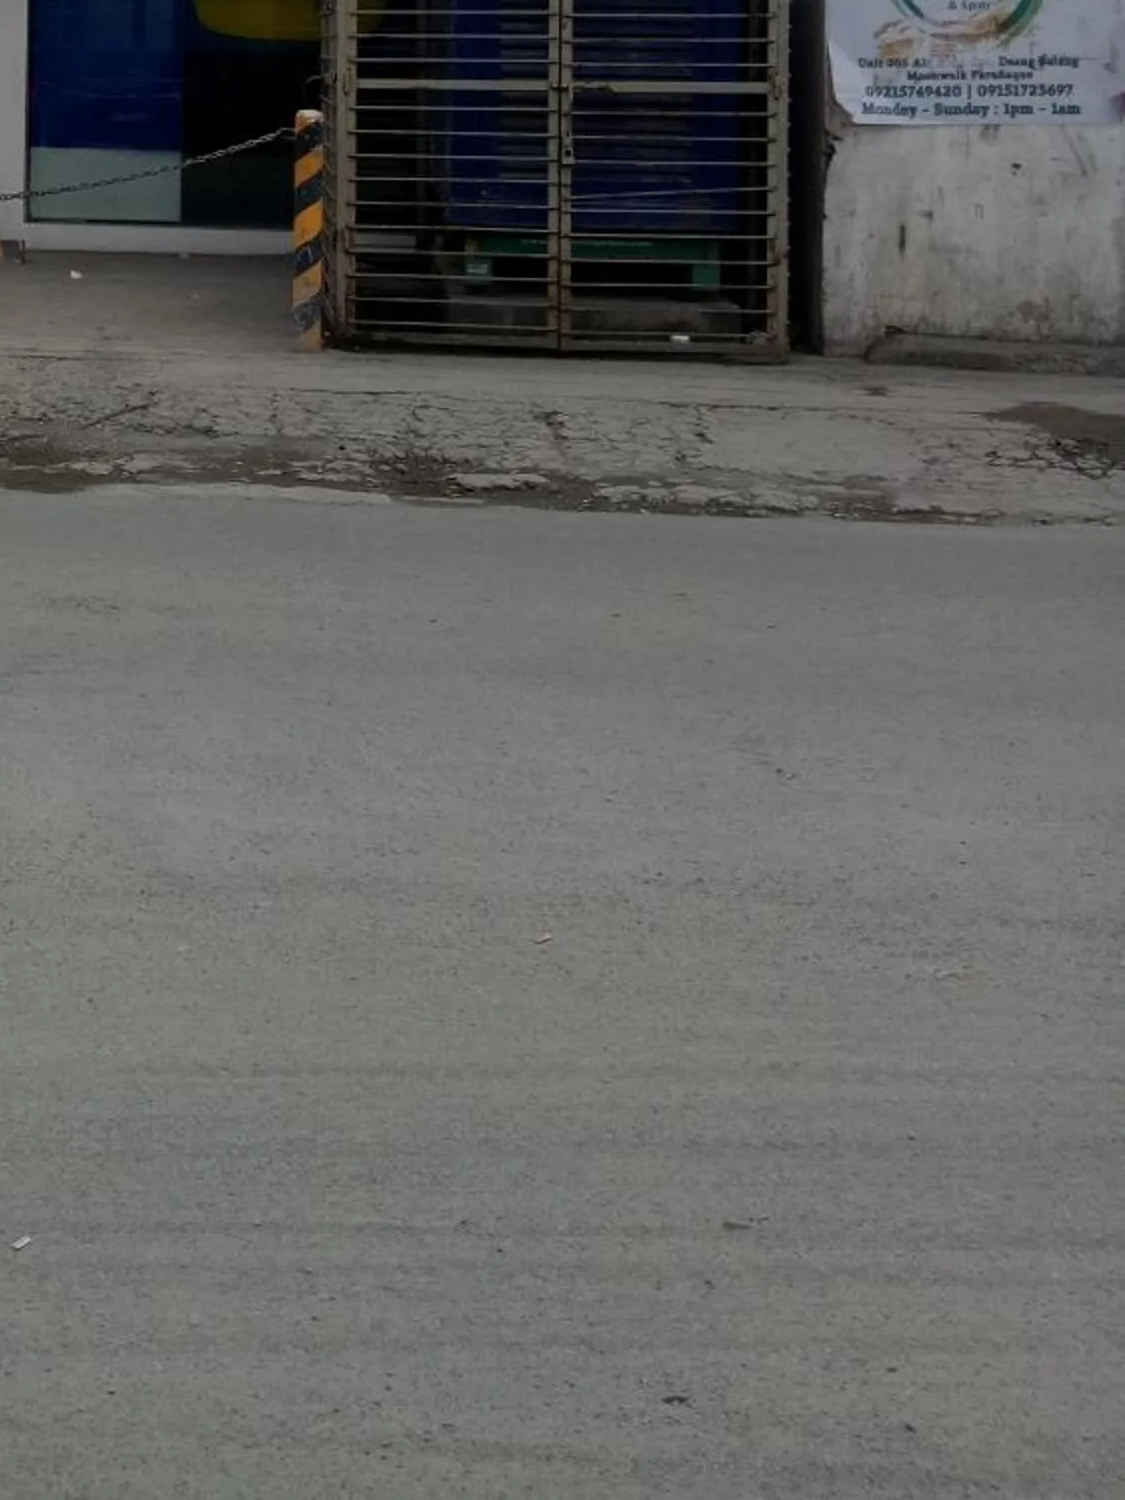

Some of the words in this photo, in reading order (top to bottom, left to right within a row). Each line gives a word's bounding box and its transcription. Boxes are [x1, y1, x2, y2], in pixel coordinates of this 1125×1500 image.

[865, 85, 962, 99] 09215749420
[977, 83, 1074, 98] 09151723697
[861, 101, 917, 117] Monday
[933, 102, 990, 118] Sunday
[1003, 103, 1034, 118] 1pm
